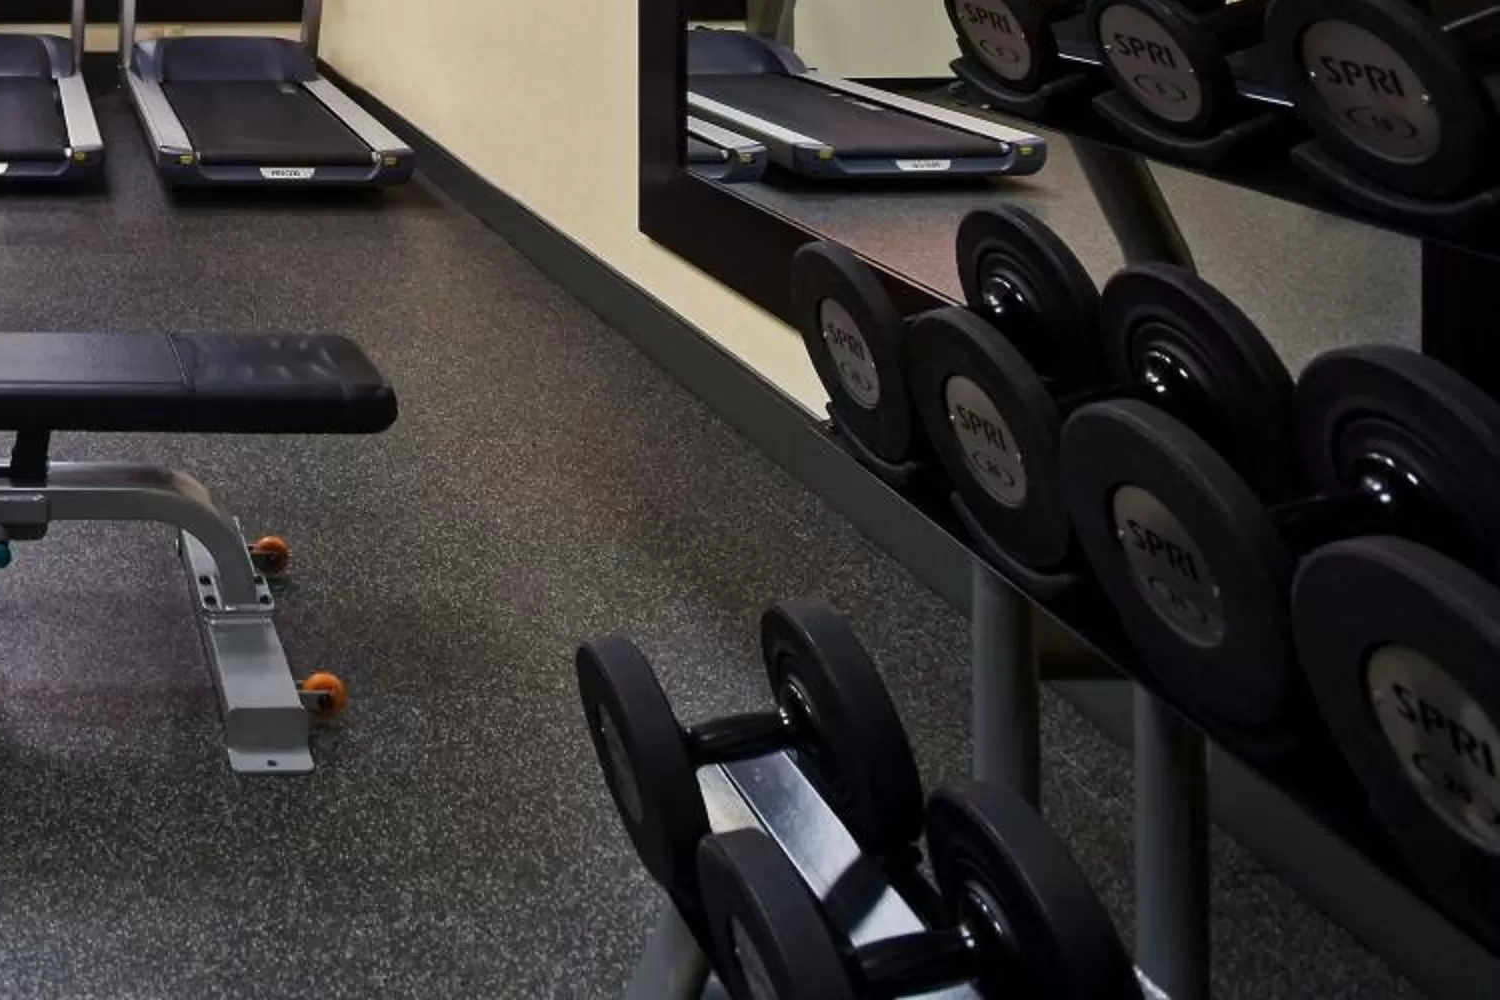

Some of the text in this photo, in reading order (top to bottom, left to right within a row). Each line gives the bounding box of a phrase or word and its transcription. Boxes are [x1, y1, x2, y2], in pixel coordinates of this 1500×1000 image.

[963, 3, 1013, 35] SPRI
[1113, 33, 1178, 70] SPRI
[1319, 55, 1406, 98] SPRI
[956, 403, 1008, 453] SPRI
[1127, 519, 1200, 583] SPRI
[1391, 683, 1497, 778] SPRI
